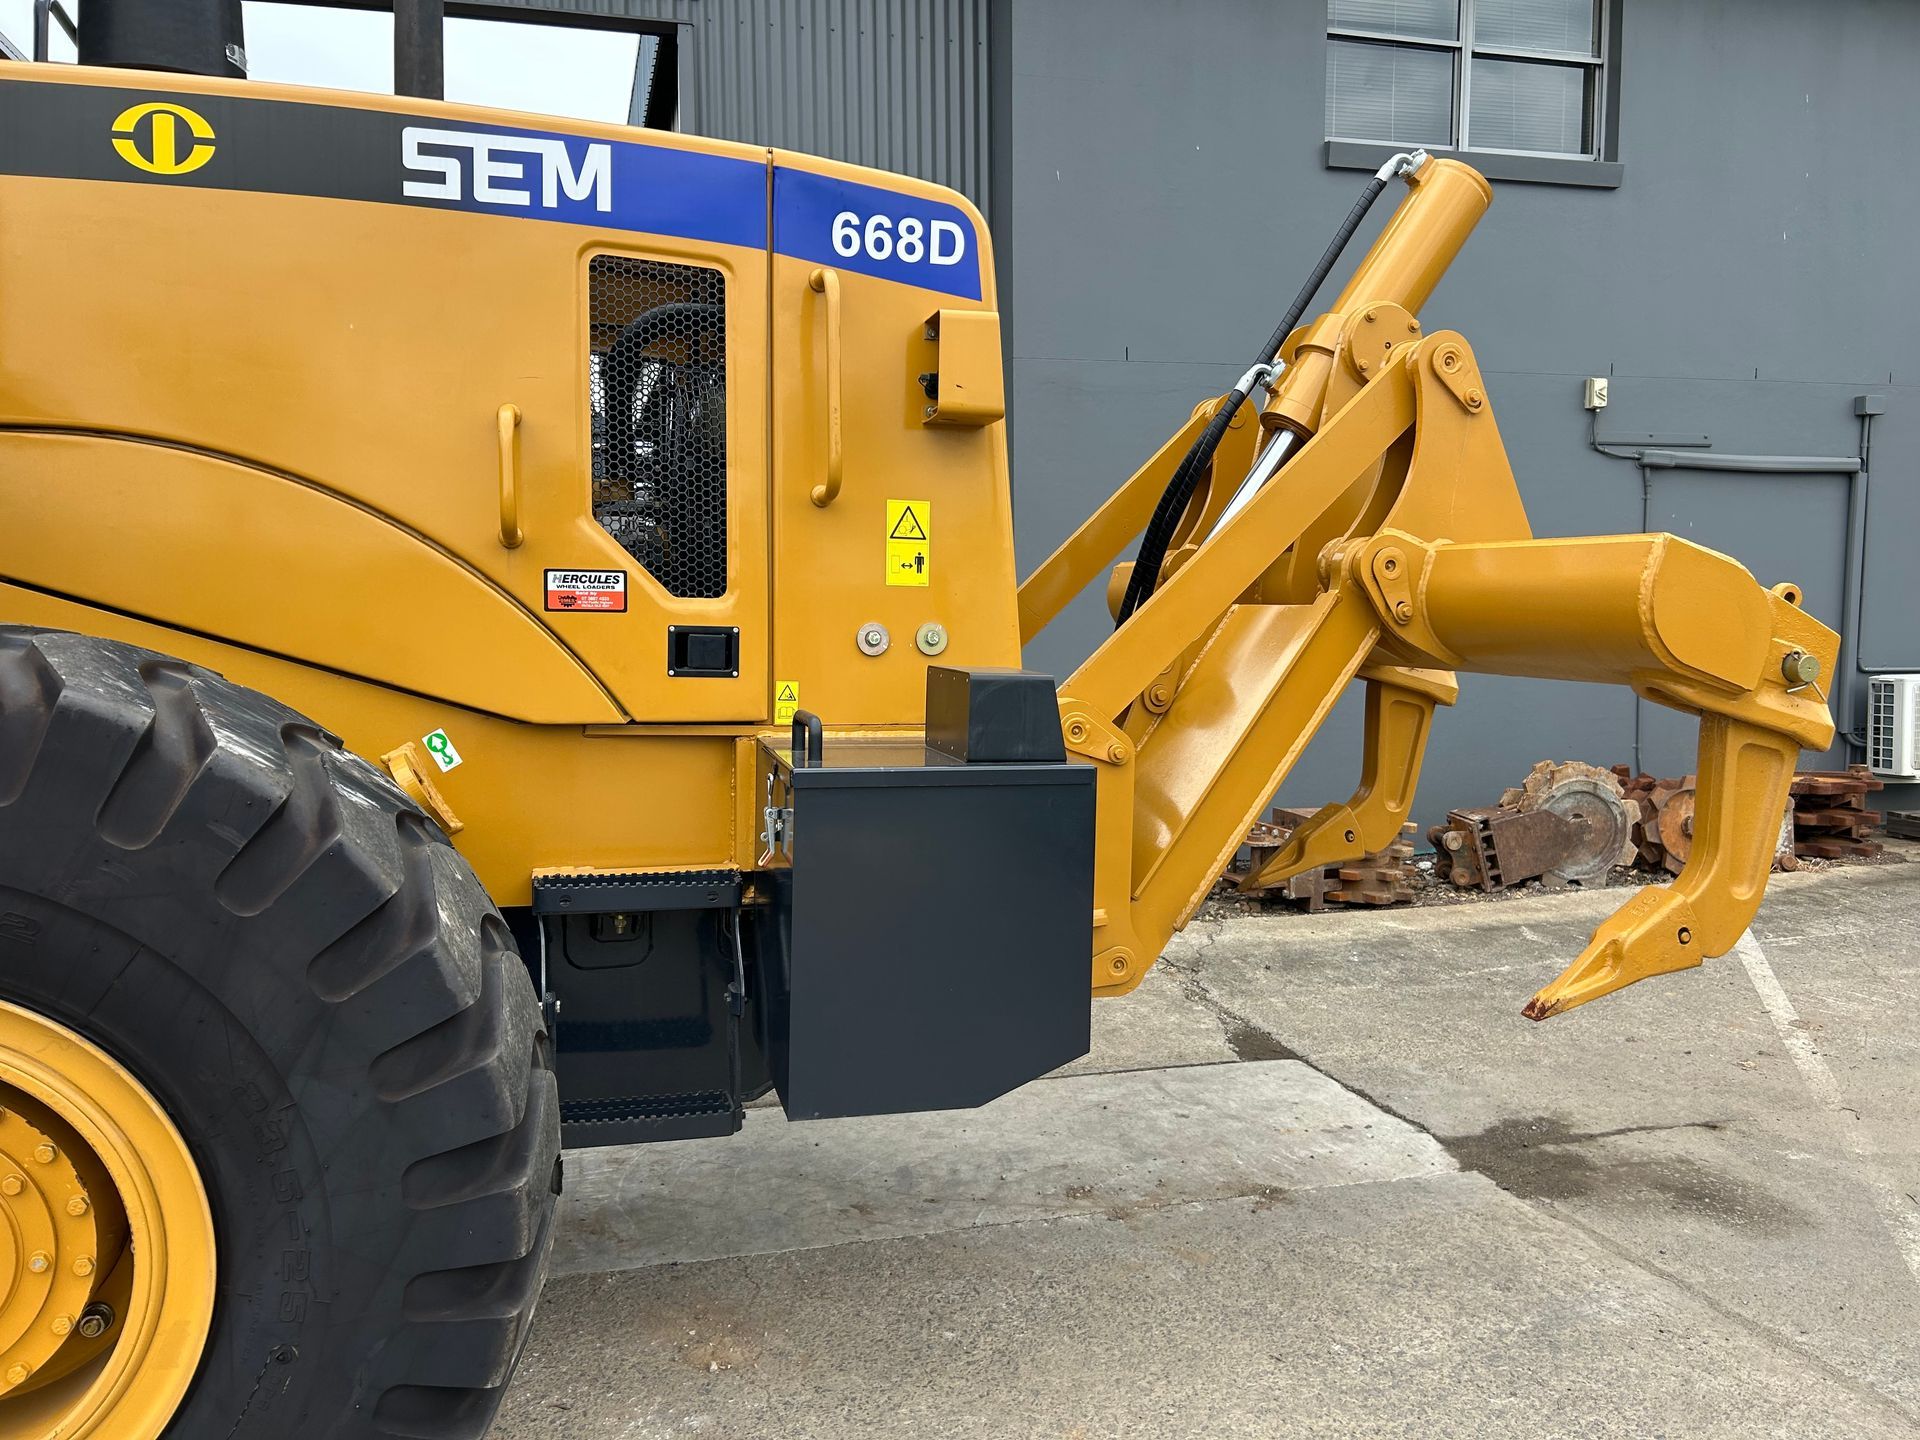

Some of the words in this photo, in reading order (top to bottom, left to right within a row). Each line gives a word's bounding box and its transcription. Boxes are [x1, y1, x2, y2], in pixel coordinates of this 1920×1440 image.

[402, 127, 611, 212] SEM
[832, 211, 965, 266] 668D
[552, 574, 620, 585] HERCULES
